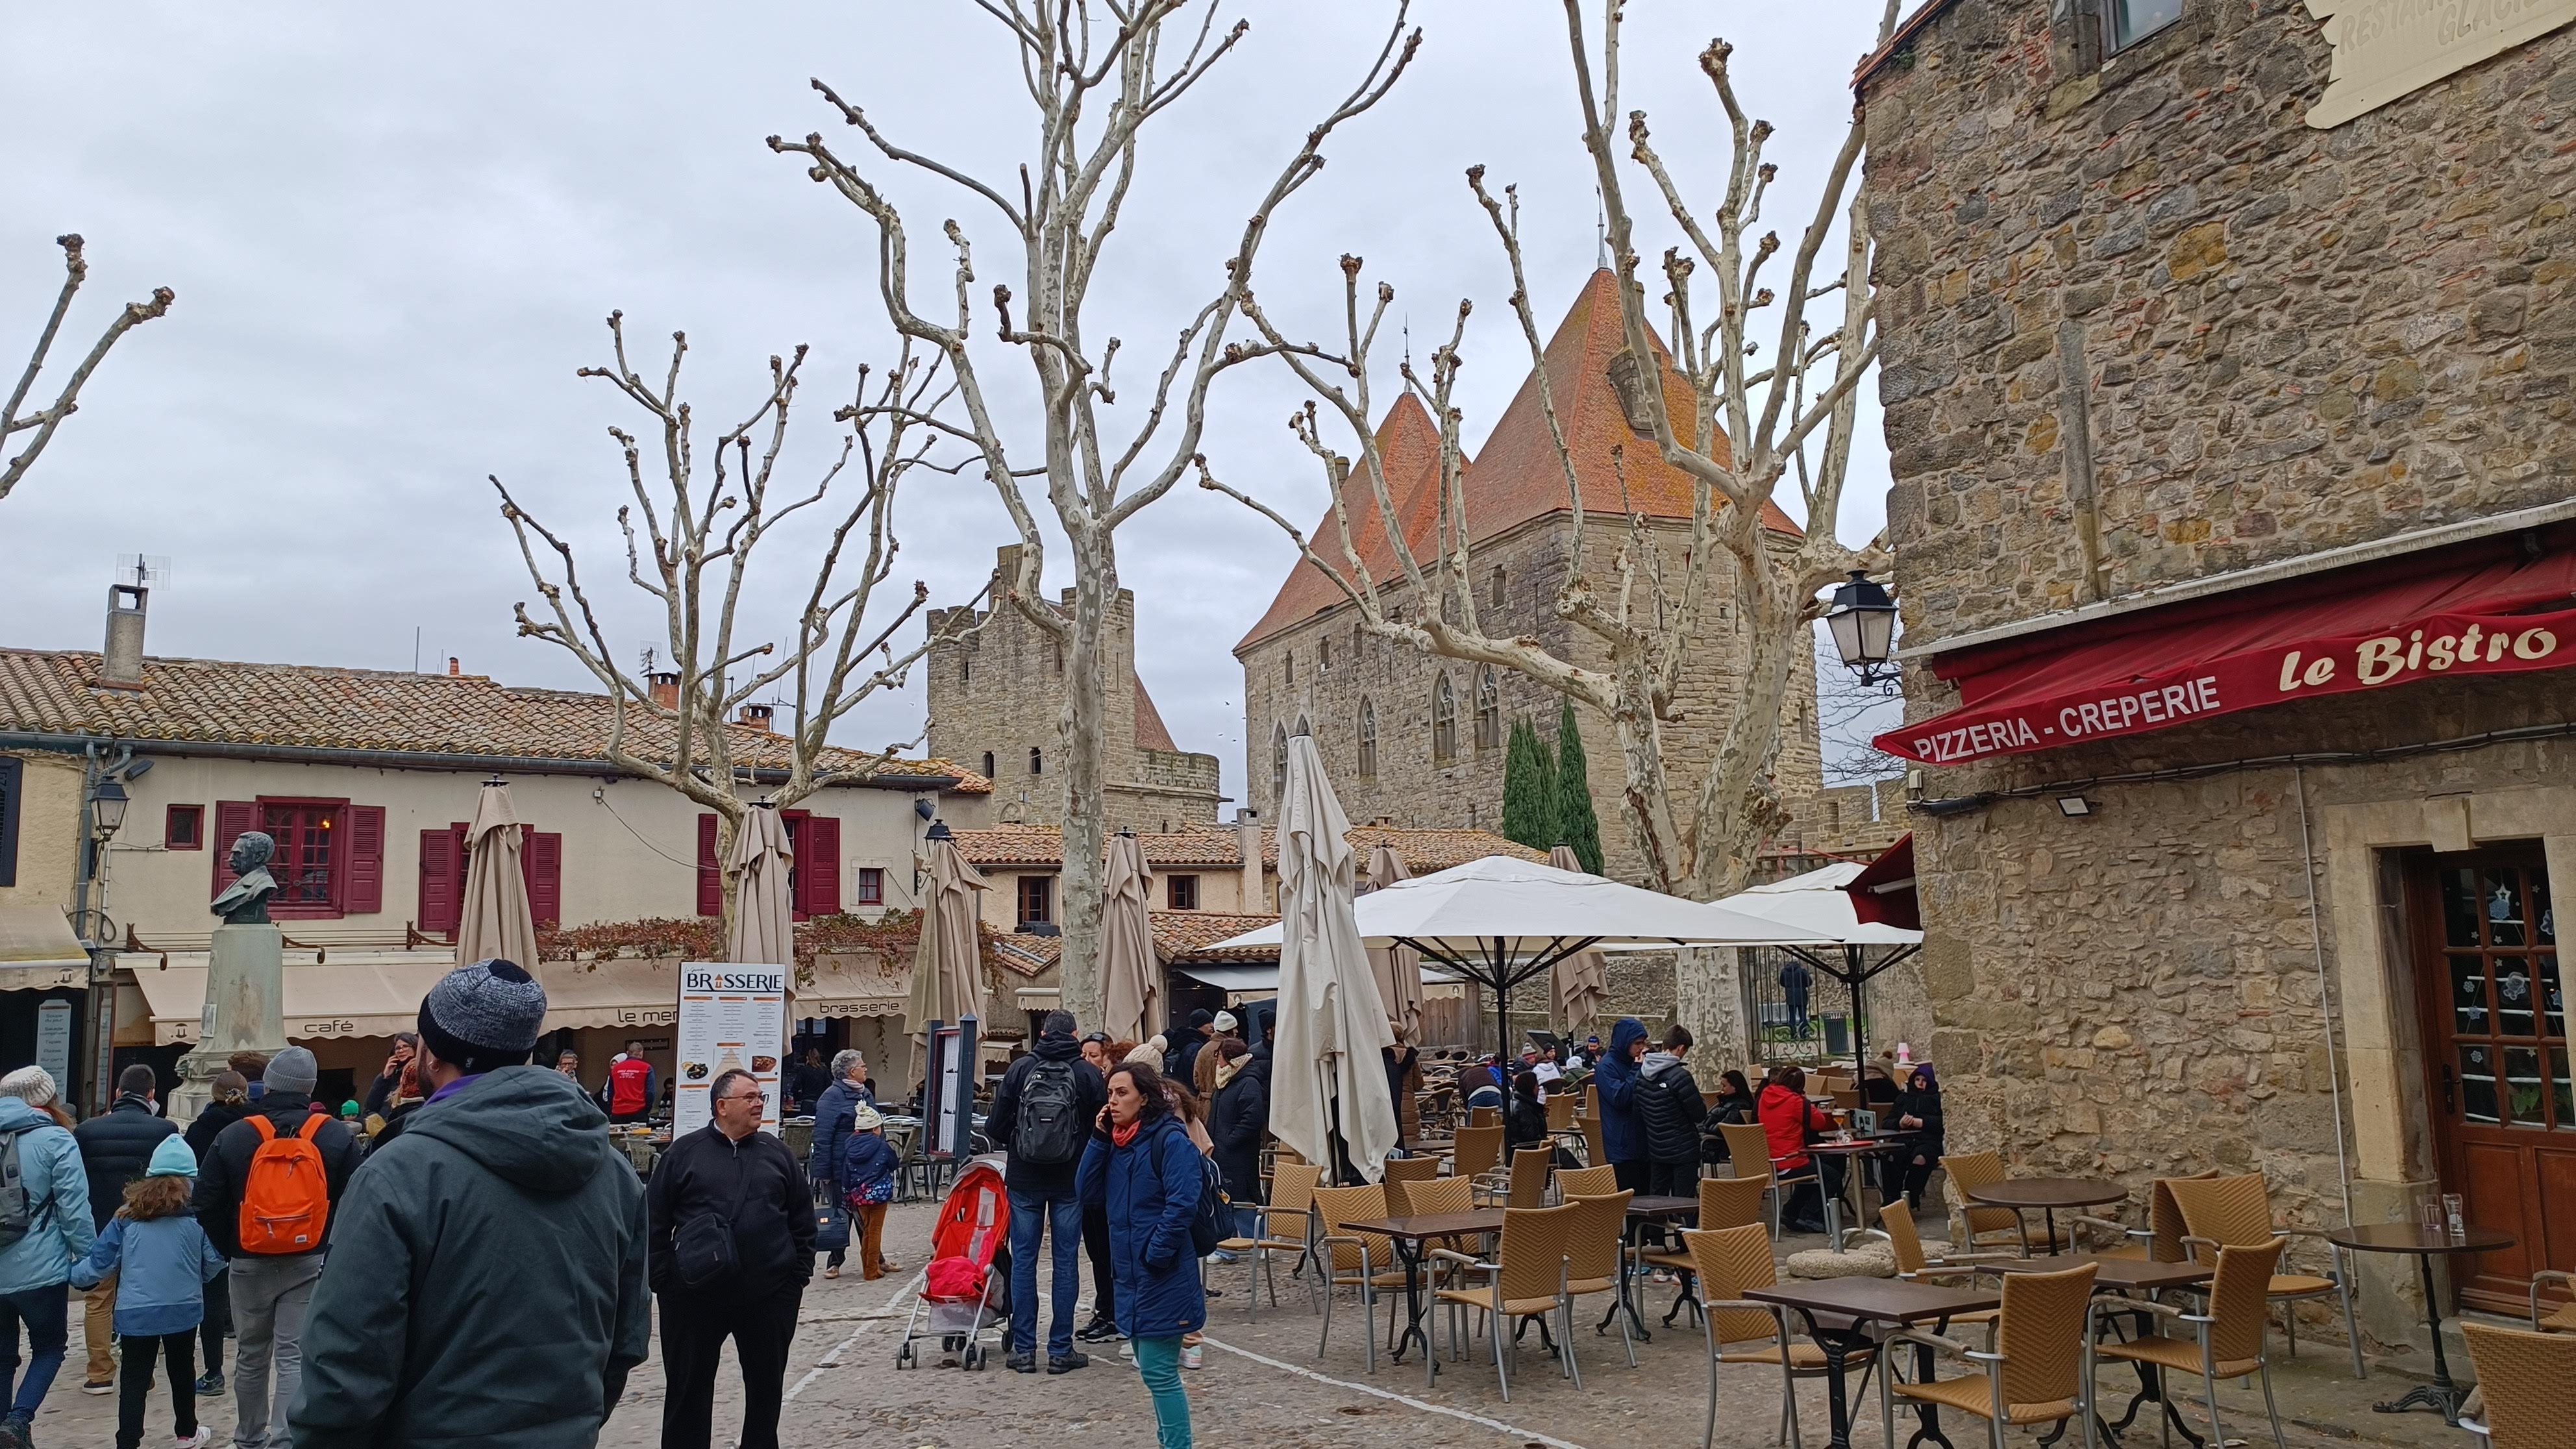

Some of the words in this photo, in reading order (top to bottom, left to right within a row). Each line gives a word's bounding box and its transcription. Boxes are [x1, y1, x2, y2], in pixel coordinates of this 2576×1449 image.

[2340, 0, 2453, 55] RESTA
[2279, 650, 2335, 691] Le
[2355, 623, 2557, 685] Bistro
[1914, 717, 2039, 762] PIZZERIA
[2059, 676, 2220, 737] CREPERIE
[617, 1008, 636, 1022] le
[819, 1000, 899, 1013] brasserie
[304, 1020, 354, 1033] café
